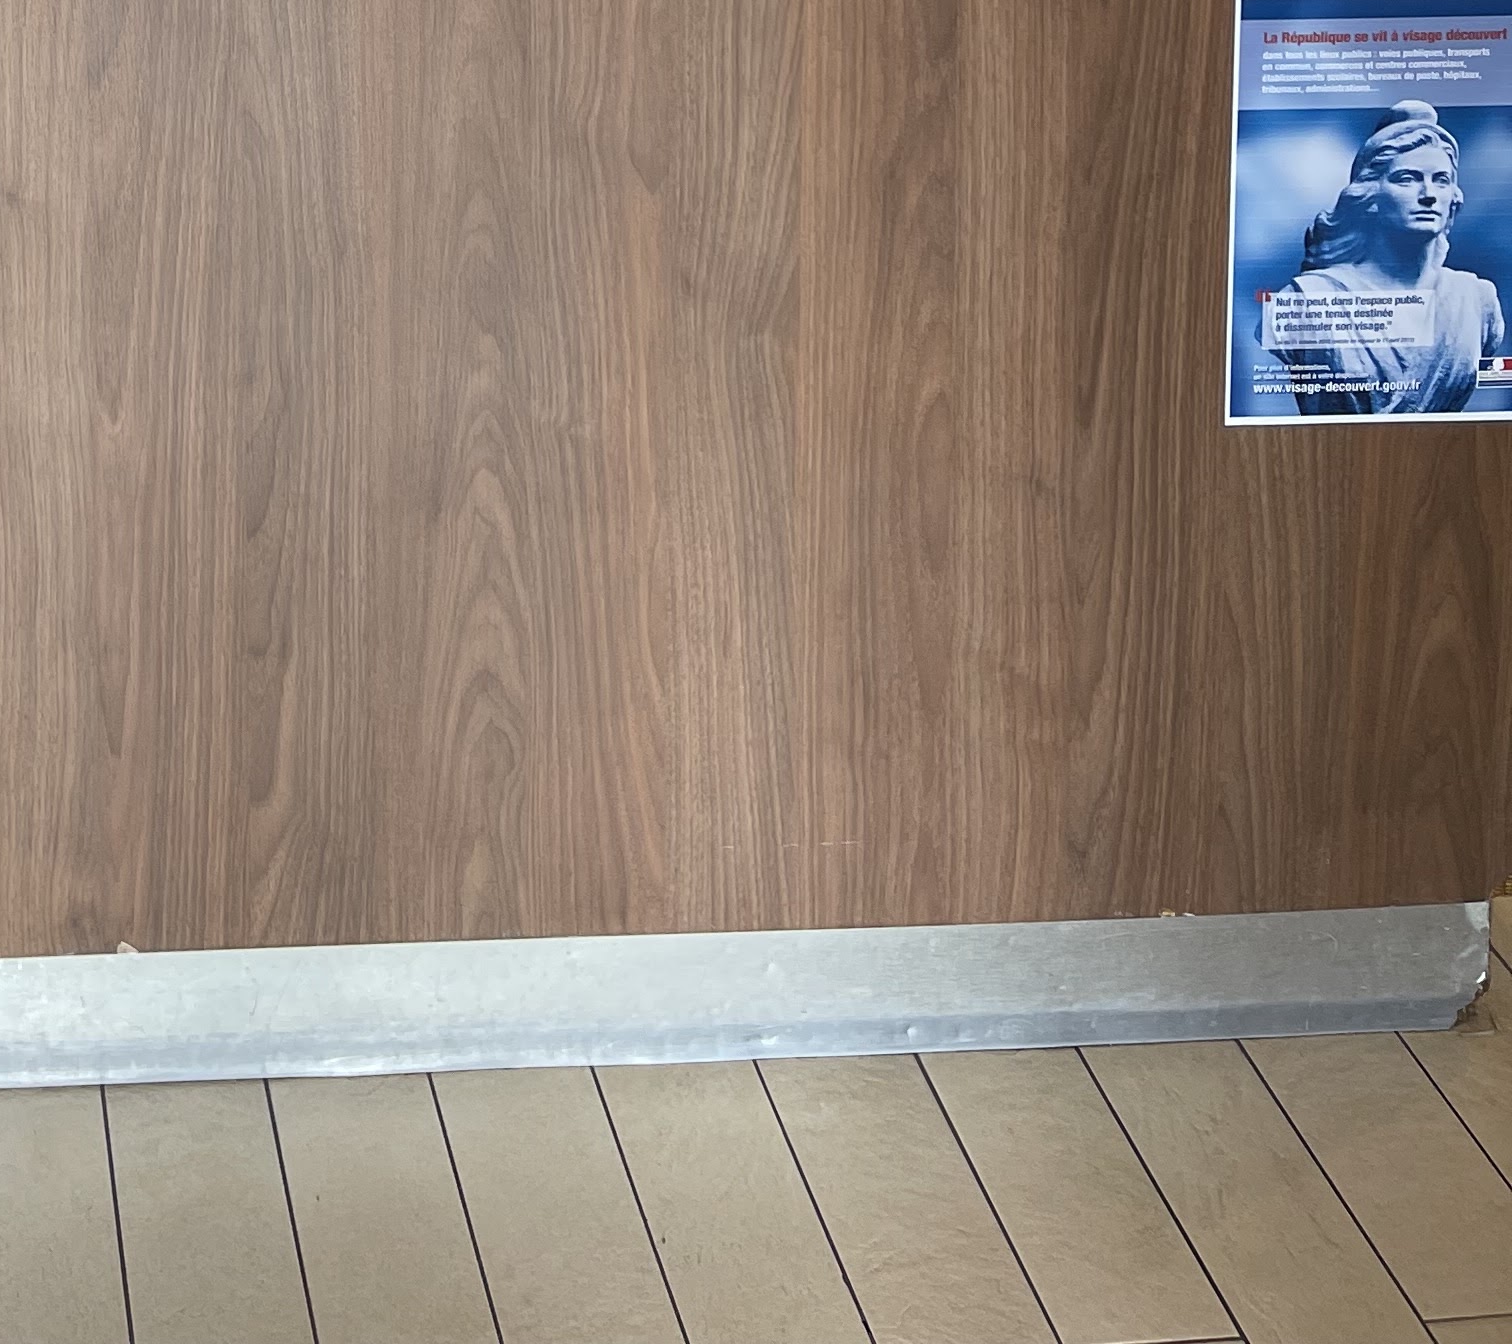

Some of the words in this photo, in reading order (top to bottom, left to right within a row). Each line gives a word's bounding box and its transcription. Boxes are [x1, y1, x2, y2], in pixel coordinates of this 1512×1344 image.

[1263, 32, 1277, 44] La
[1282, 30, 1351, 46] République
[1354, 33, 1368, 43] se
[1372, 30, 1387, 42] vit
[1391, 30, 1398, 41] à
[1403, 30, 1442, 43] visage
[1446, 28, 1507, 41] découvert
[1276, 297, 1291, 306] Nul
[1293, 298, 1305, 306] ne
[1307, 297, 1329, 308] peut,
[1331, 296, 1353, 306] dans
[1356, 296, 1392, 307] l'espace
[1395, 294, 1425, 306] public,
[1253, 380, 1421, 394] www.visage-decouvert.gouv.fr
